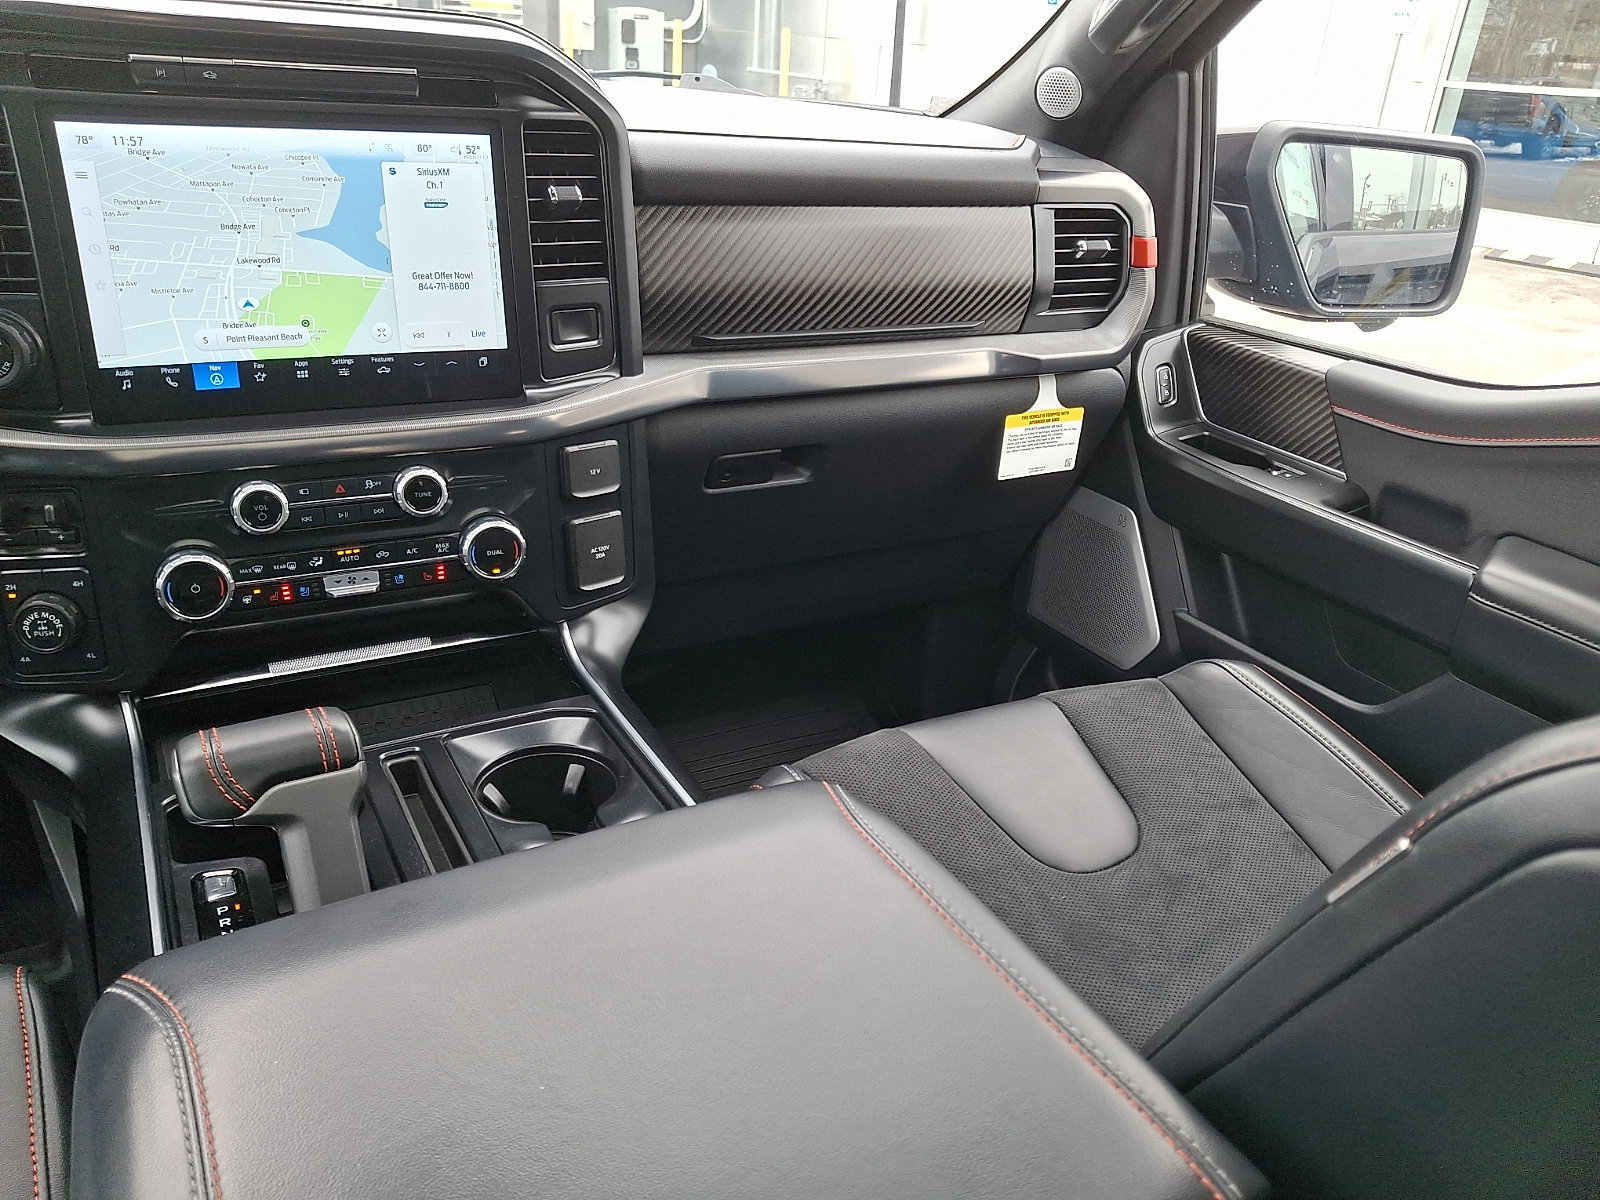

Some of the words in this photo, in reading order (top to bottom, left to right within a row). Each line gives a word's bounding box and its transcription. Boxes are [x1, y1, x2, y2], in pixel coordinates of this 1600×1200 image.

[112, 136, 143, 147] 11:57
[127, 148, 150, 157] Bridge
[416, 168, 450, 176] SiriusXM
[189, 180, 221, 189] Mattapan
[220, 223, 242, 232] Bridge
[412, 272, 433, 280] Great
[434, 272, 452, 280] Offer
[454, 272, 474, 280] Now!
[226, 334, 246, 343] Point
[248, 334, 280, 342] Pleasant
[280, 332, 302, 341] Beach
[472, 330, 486, 338] Live
[332, 358, 354, 366] Settings
[160, 366, 180, 374] Phone
[340, 554, 360, 562] AUTO
[23, 612, 40, 631] DRIVE
[41, 612, 63, 629] MODE
[217, 906, 229, 916] P
[219, 918, 232, 928] R
